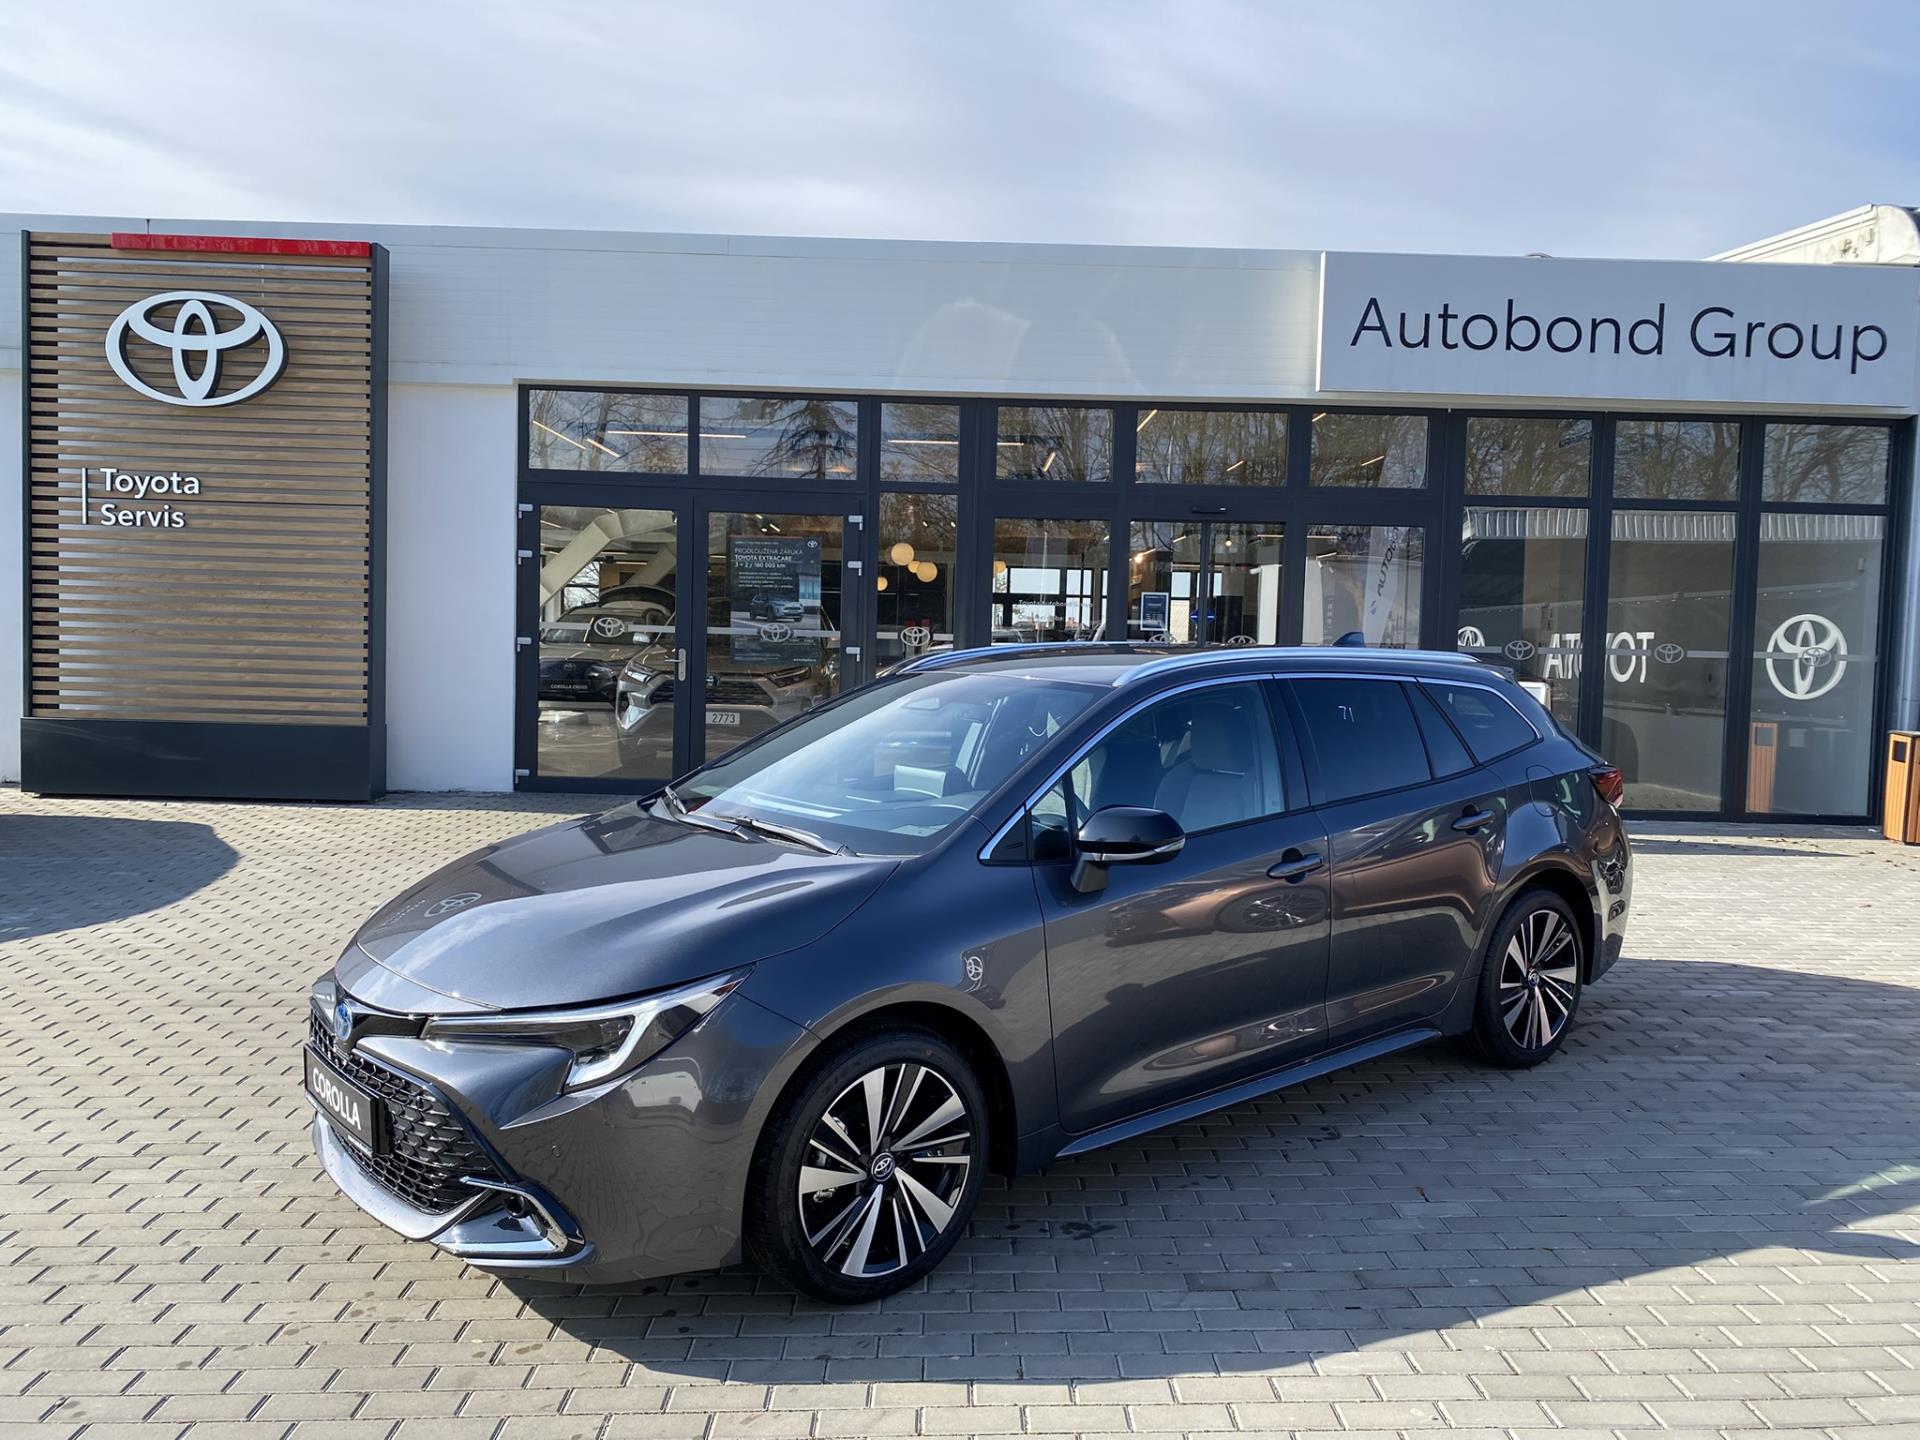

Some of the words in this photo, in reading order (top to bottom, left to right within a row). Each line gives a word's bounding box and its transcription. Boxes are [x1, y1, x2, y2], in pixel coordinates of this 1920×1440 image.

[1350, 297, 1666, 356] Autobond
[1690, 306, 1888, 374] Group
[100, 467, 201, 499] Toyota
[100, 503, 185, 528] Servis
[711, 712, 736, 724] 2773
[312, 1066, 362, 1131] COROLLA
